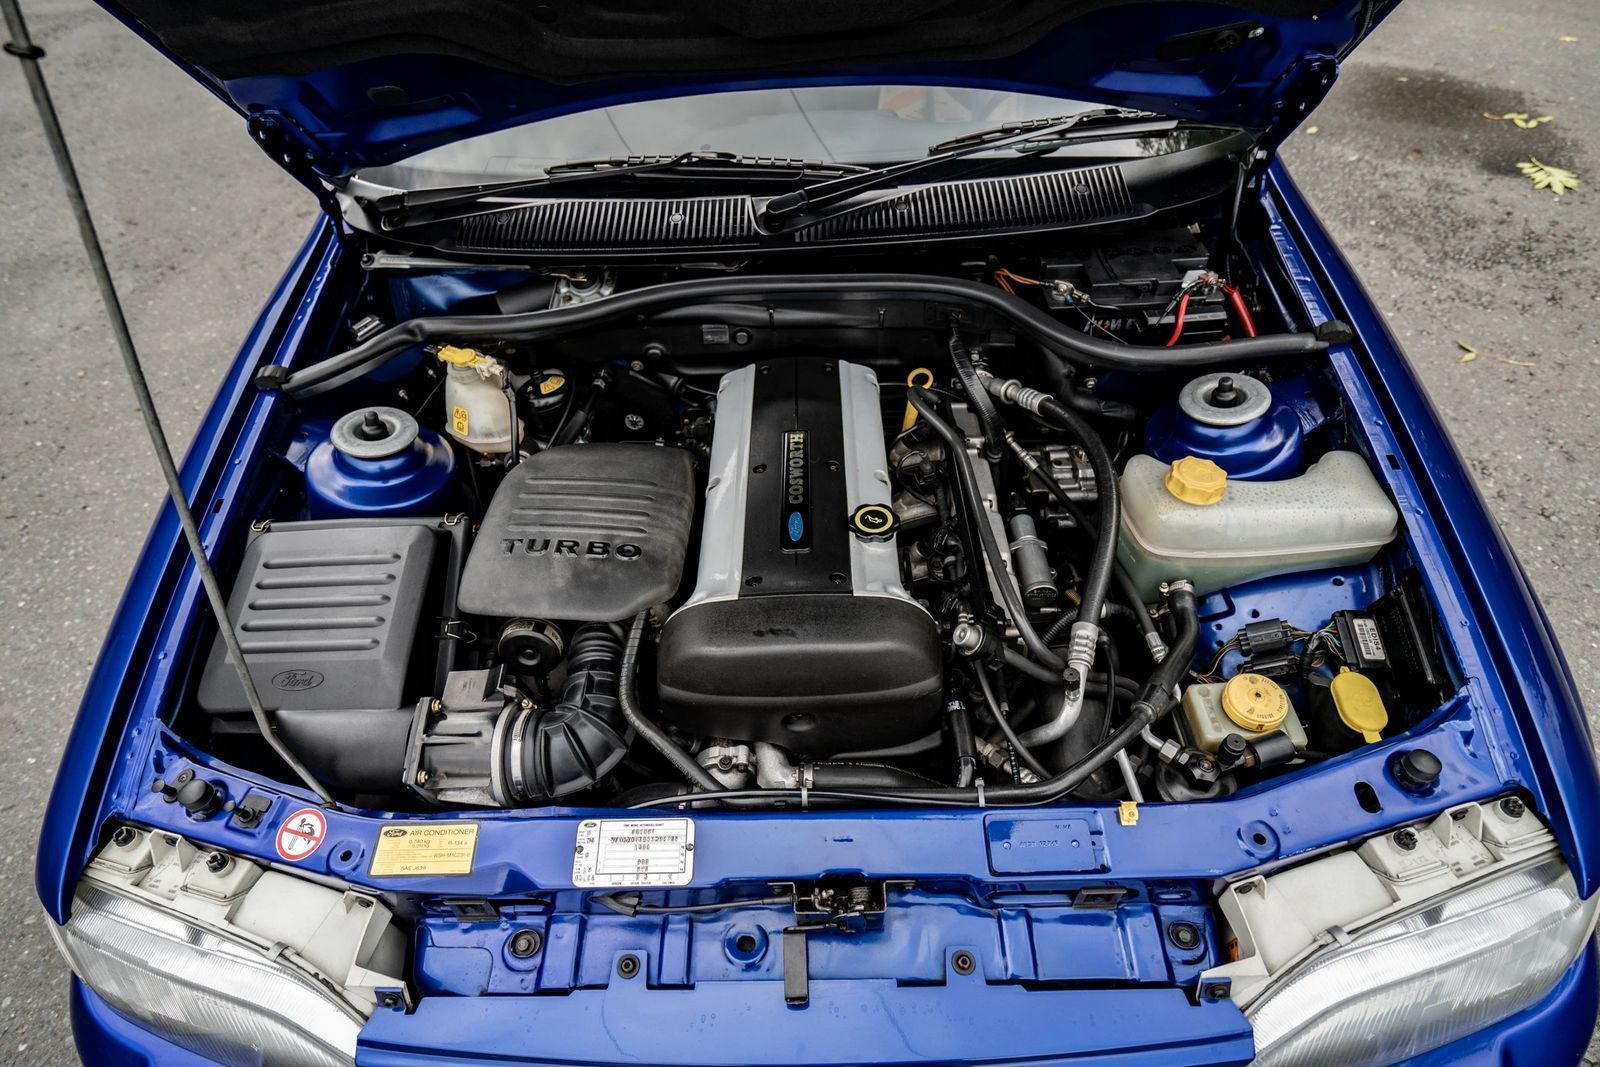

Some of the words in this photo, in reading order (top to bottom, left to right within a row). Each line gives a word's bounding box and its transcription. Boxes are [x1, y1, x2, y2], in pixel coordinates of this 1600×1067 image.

[788, 432, 804, 505] COSWORTH
[502, 538, 642, 560] TURBO
[1369, 627, 1382, 650] EDIS4
[423, 828, 474, 836] CONDITIONER
